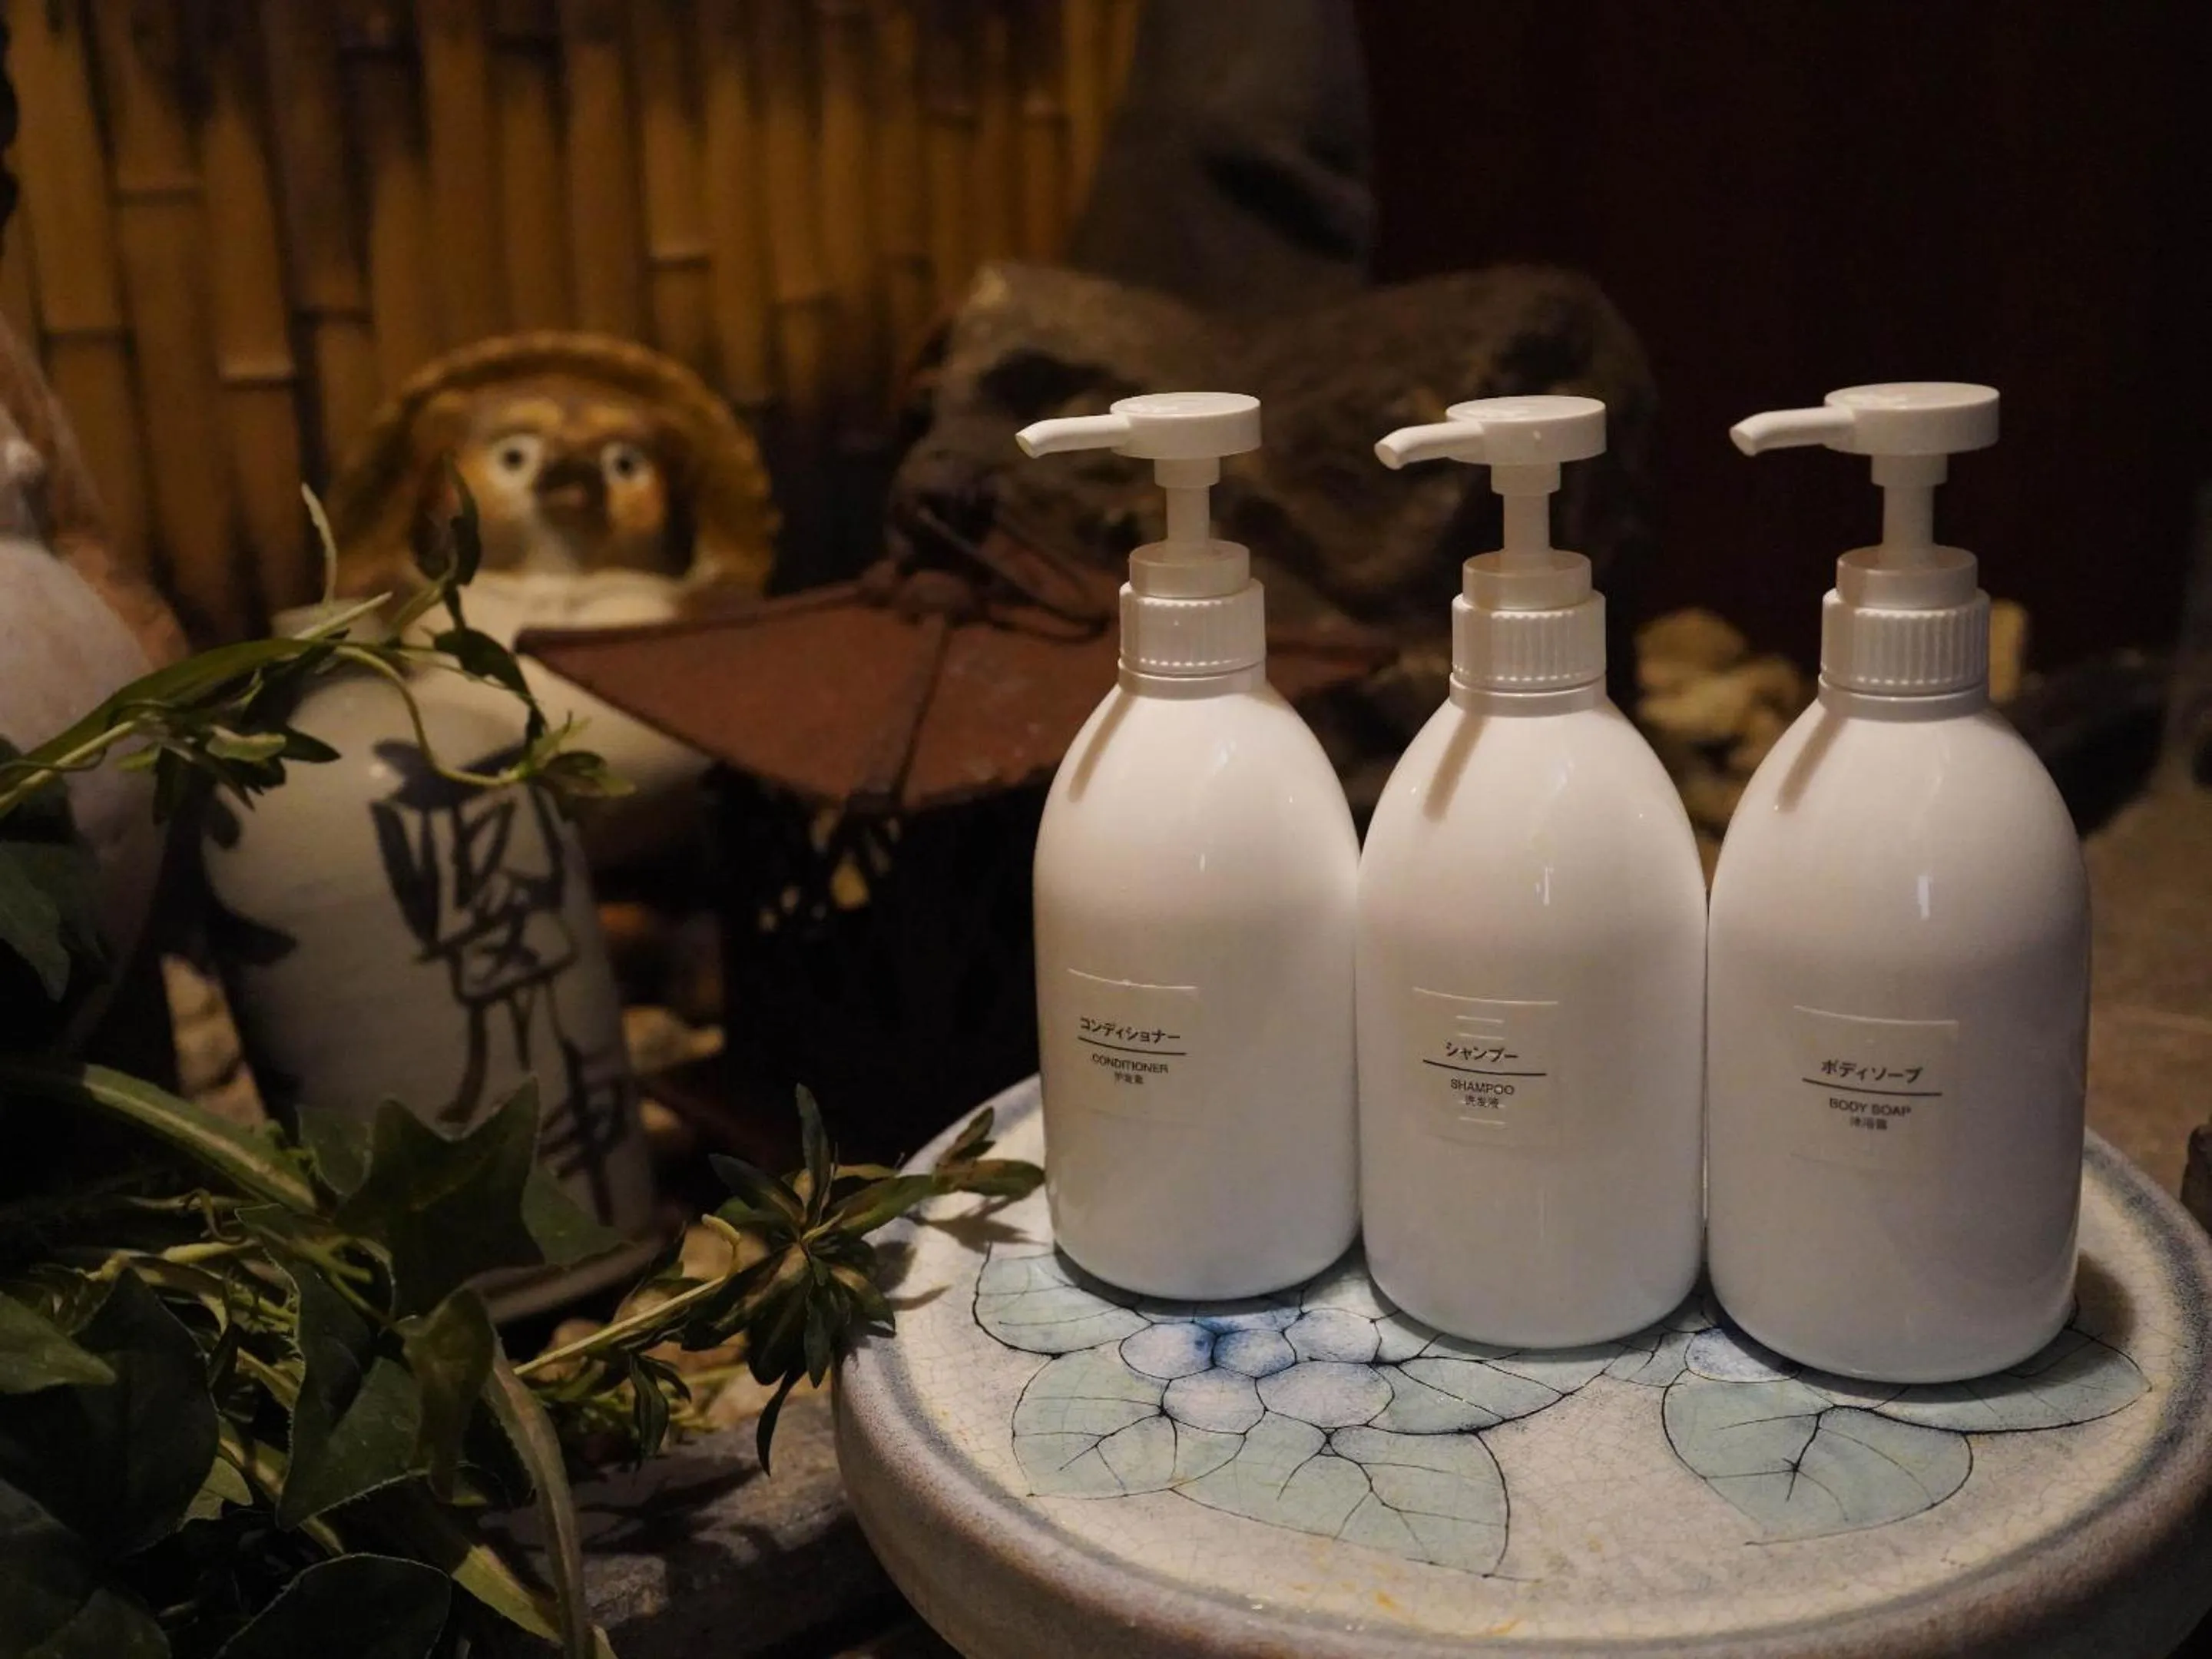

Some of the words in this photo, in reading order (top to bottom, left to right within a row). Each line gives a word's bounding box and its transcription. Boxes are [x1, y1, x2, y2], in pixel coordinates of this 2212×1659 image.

[1079, 1016, 1181, 1044] コンディショナー
[1445, 1041, 1519, 1063] シャンプー
[1091, 1053, 1169, 1074] CONDITIONER
[1820, 1058, 1924, 1084] ボディソープ
[1450, 1078, 1515, 1096] SHAMPOO
[1829, 1097, 1867, 1113] BODY
[1871, 1103, 1912, 1118] SOAP
